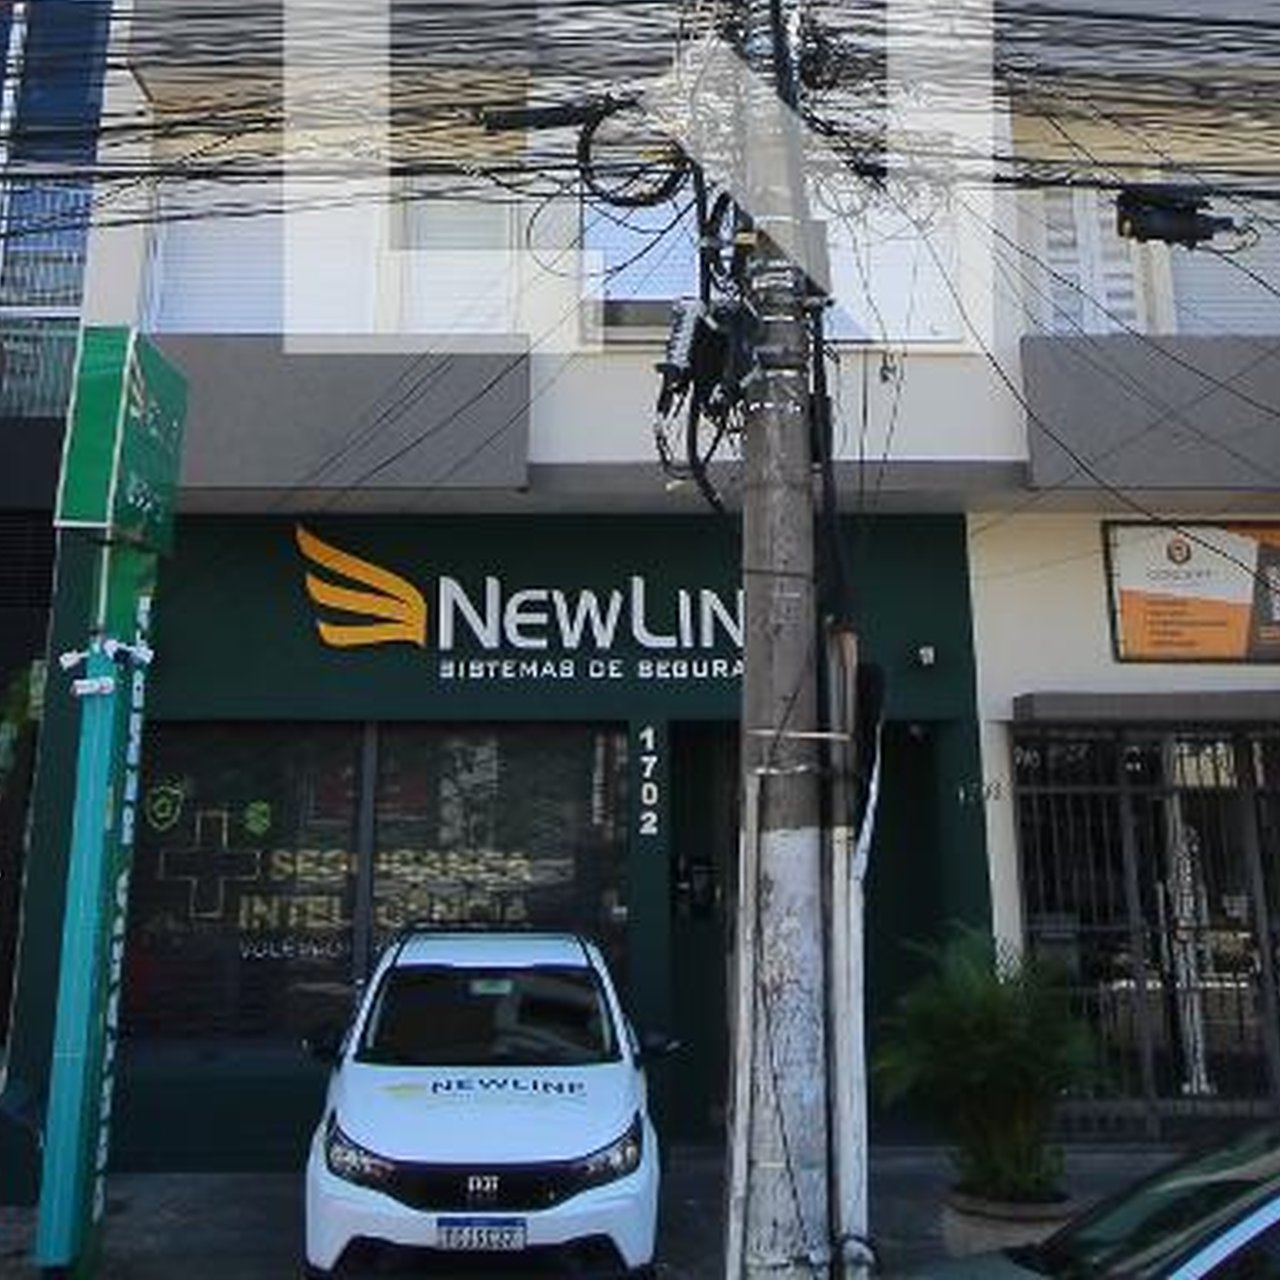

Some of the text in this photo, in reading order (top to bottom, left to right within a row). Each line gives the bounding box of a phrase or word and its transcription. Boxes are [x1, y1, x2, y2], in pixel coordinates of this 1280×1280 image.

[440, 659, 575, 679] SISTEMAS
[588, 659, 624, 679] DE
[639, 725, 659, 835] 1702
